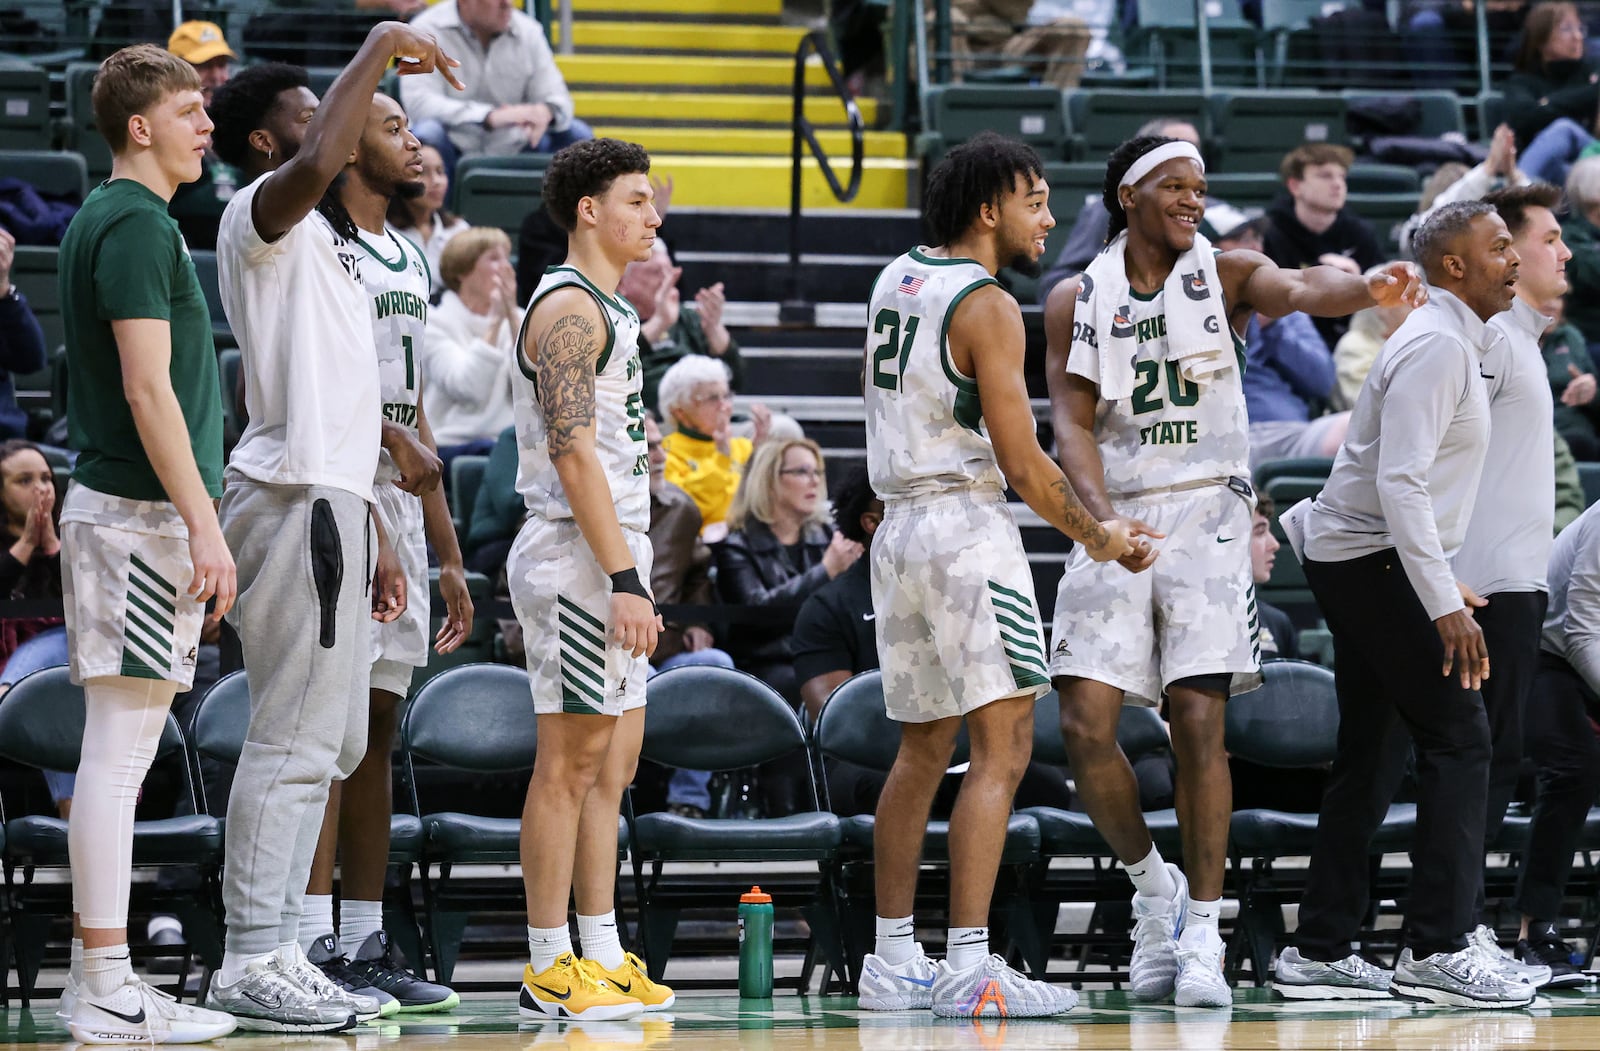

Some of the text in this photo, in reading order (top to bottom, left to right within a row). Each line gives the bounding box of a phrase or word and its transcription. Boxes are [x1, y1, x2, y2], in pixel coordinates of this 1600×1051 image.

[374, 291, 428, 326] WRIGHT
[401, 334, 415, 391] 1
[872, 307, 920, 394] 21
[1131, 358, 1200, 416] 20
[382, 402, 419, 429] STAT
[1140, 420, 1198, 446] STATE
